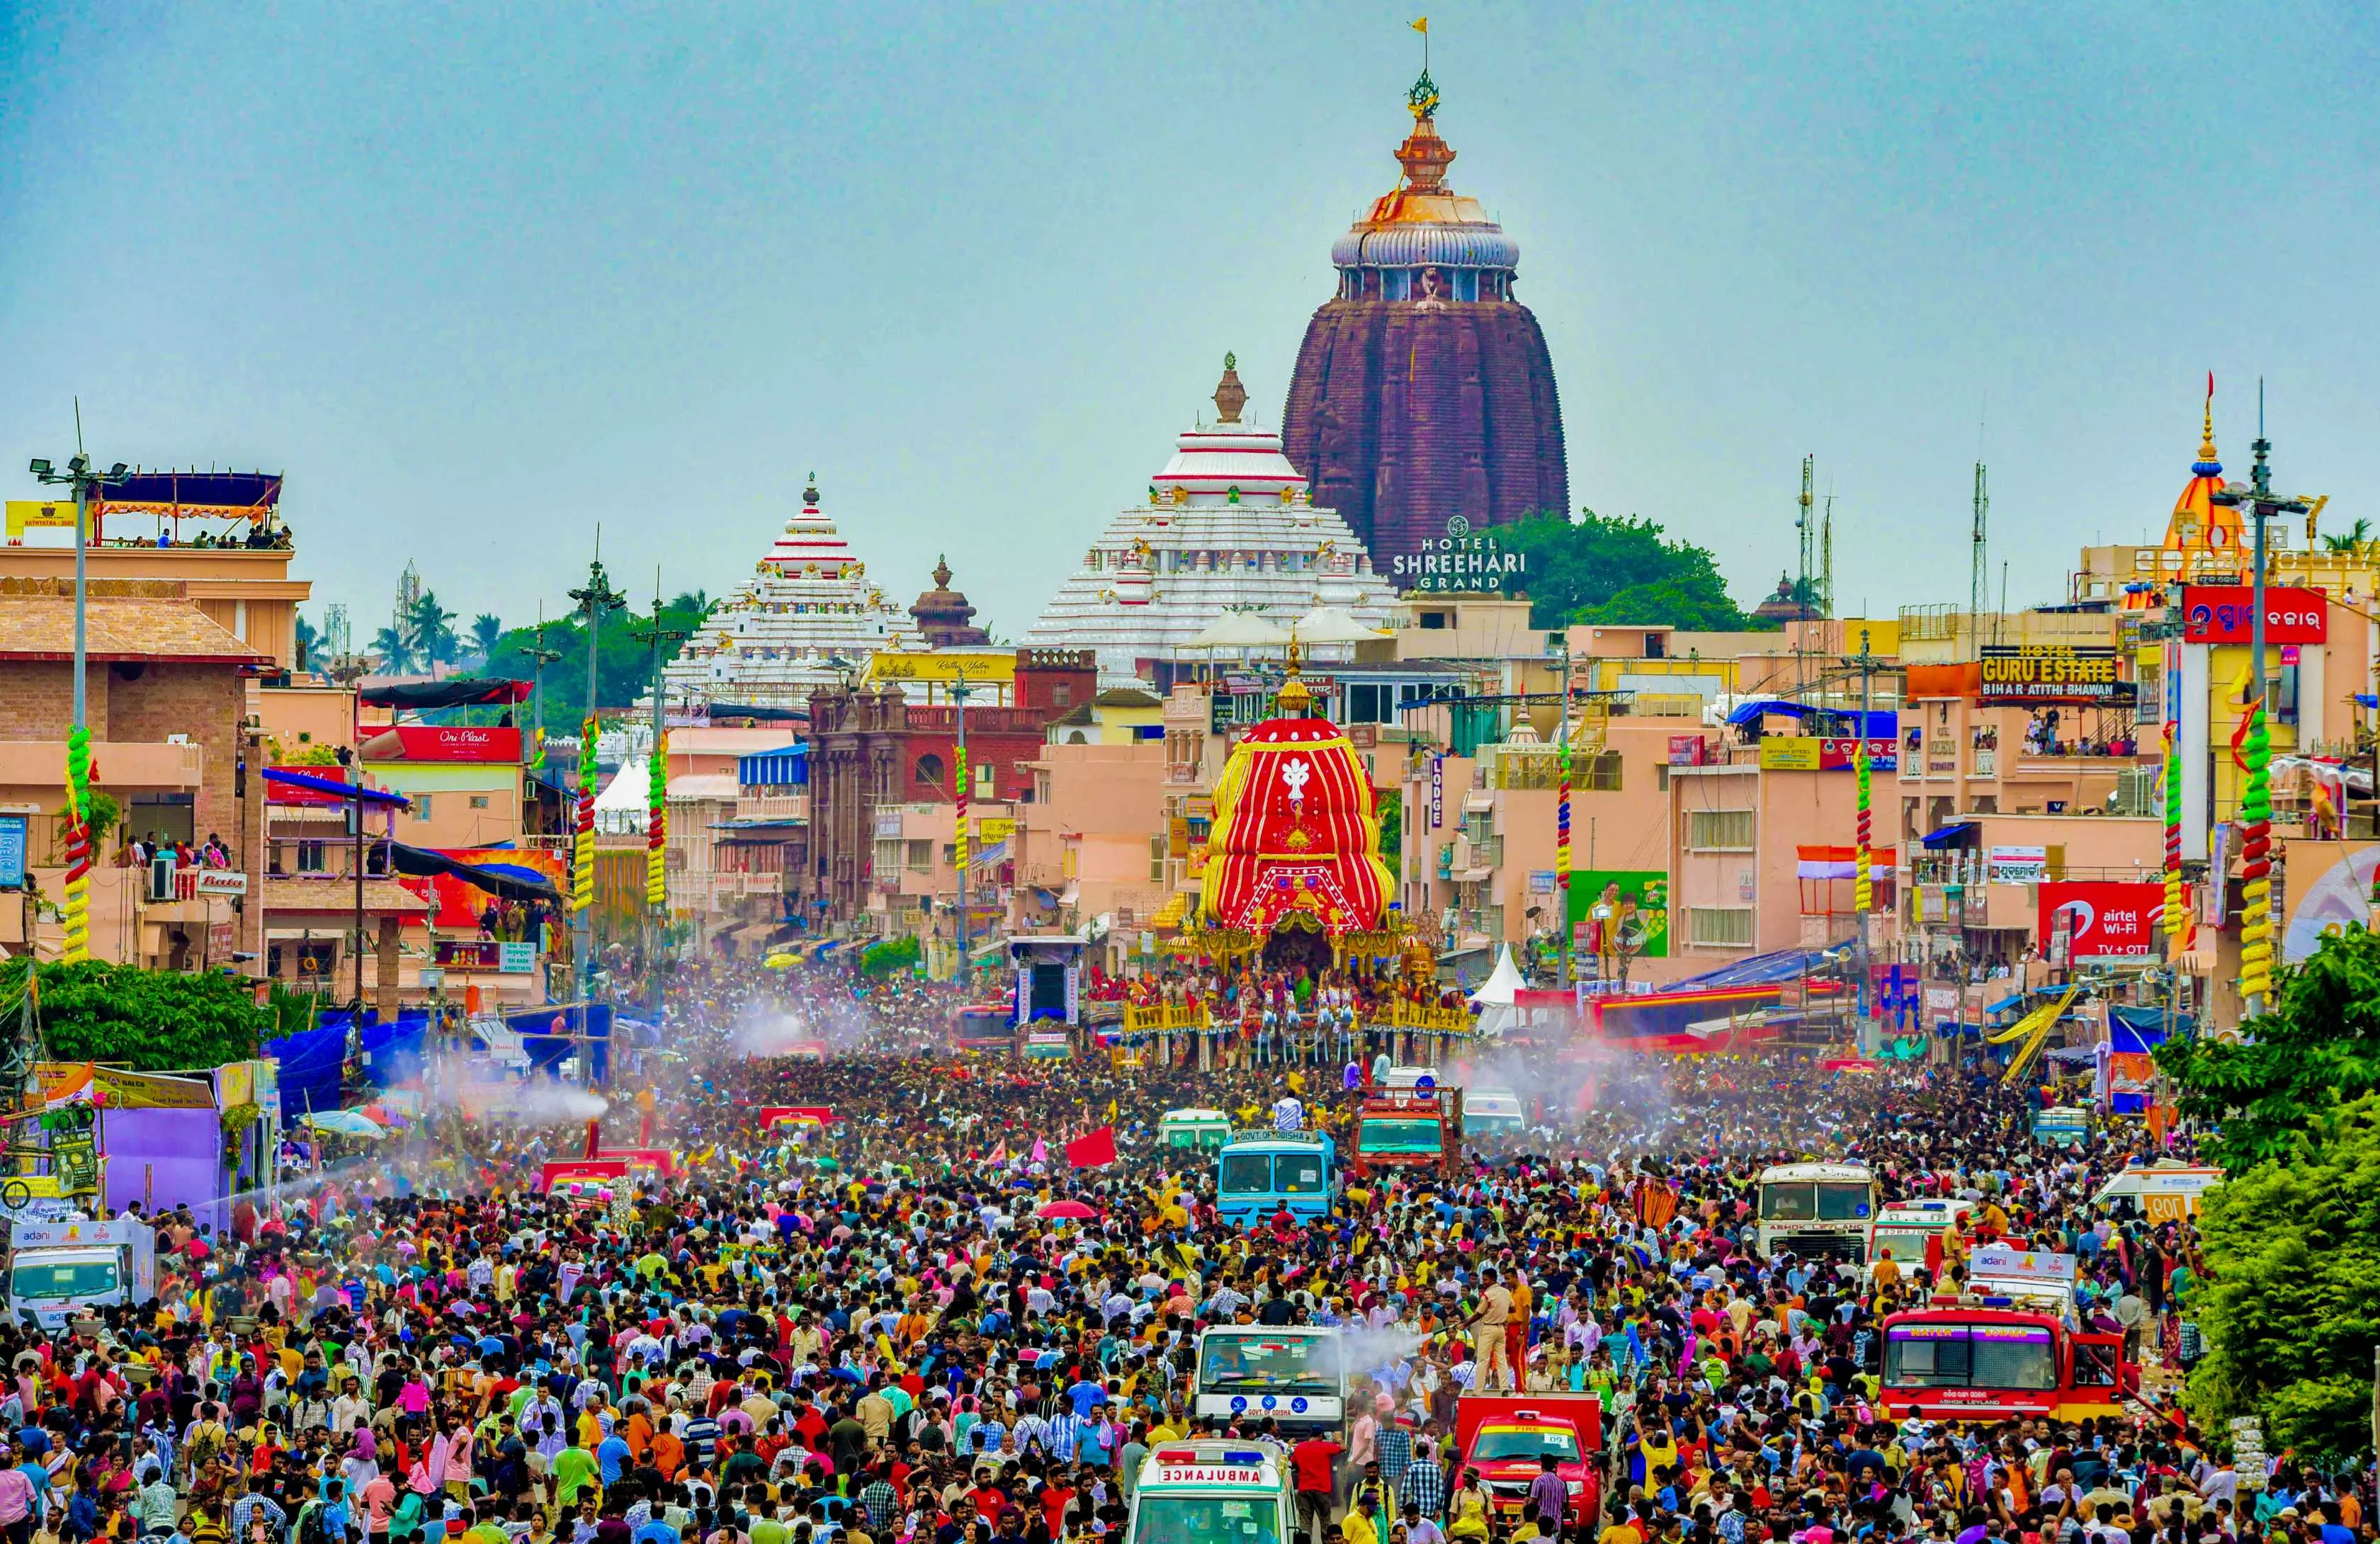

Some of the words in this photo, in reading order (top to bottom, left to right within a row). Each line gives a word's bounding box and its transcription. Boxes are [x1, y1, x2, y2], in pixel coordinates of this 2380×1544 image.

[1422, 538, 1497, 550] HOTEL
[1393, 553, 1525, 574] SHREEHARI
[1420, 577, 1499, 589] GRAND
[2020, 645, 2075, 657] HOTEL
[936, 660, 962, 670] Ratha
[963, 660, 990, 674] Yatra
[1983, 659, 2035, 681] GURU
[2041, 659, 2115, 682] ESTATE
[1983, 683, 2024, 695] BIHAR
[2028, 684, 2063, 695] ATITHI
[2067, 683, 2113, 695] BHAWAN
[1433, 760, 1441, 824] LODGE
[203, 875, 243, 887] Bata
[2103, 909, 2137, 921] airtel
[2103, 923, 2137, 934] Wi-Fi
[2097, 944, 2114, 955] TV
[2126, 944, 2150, 955] OTT
[1276, 1132, 1303, 1140] ODISHA
[23, 1230, 50, 1240] adani
[1980, 1256, 2007, 1266] adani
[1910, 1328, 1952, 1337] WATER
